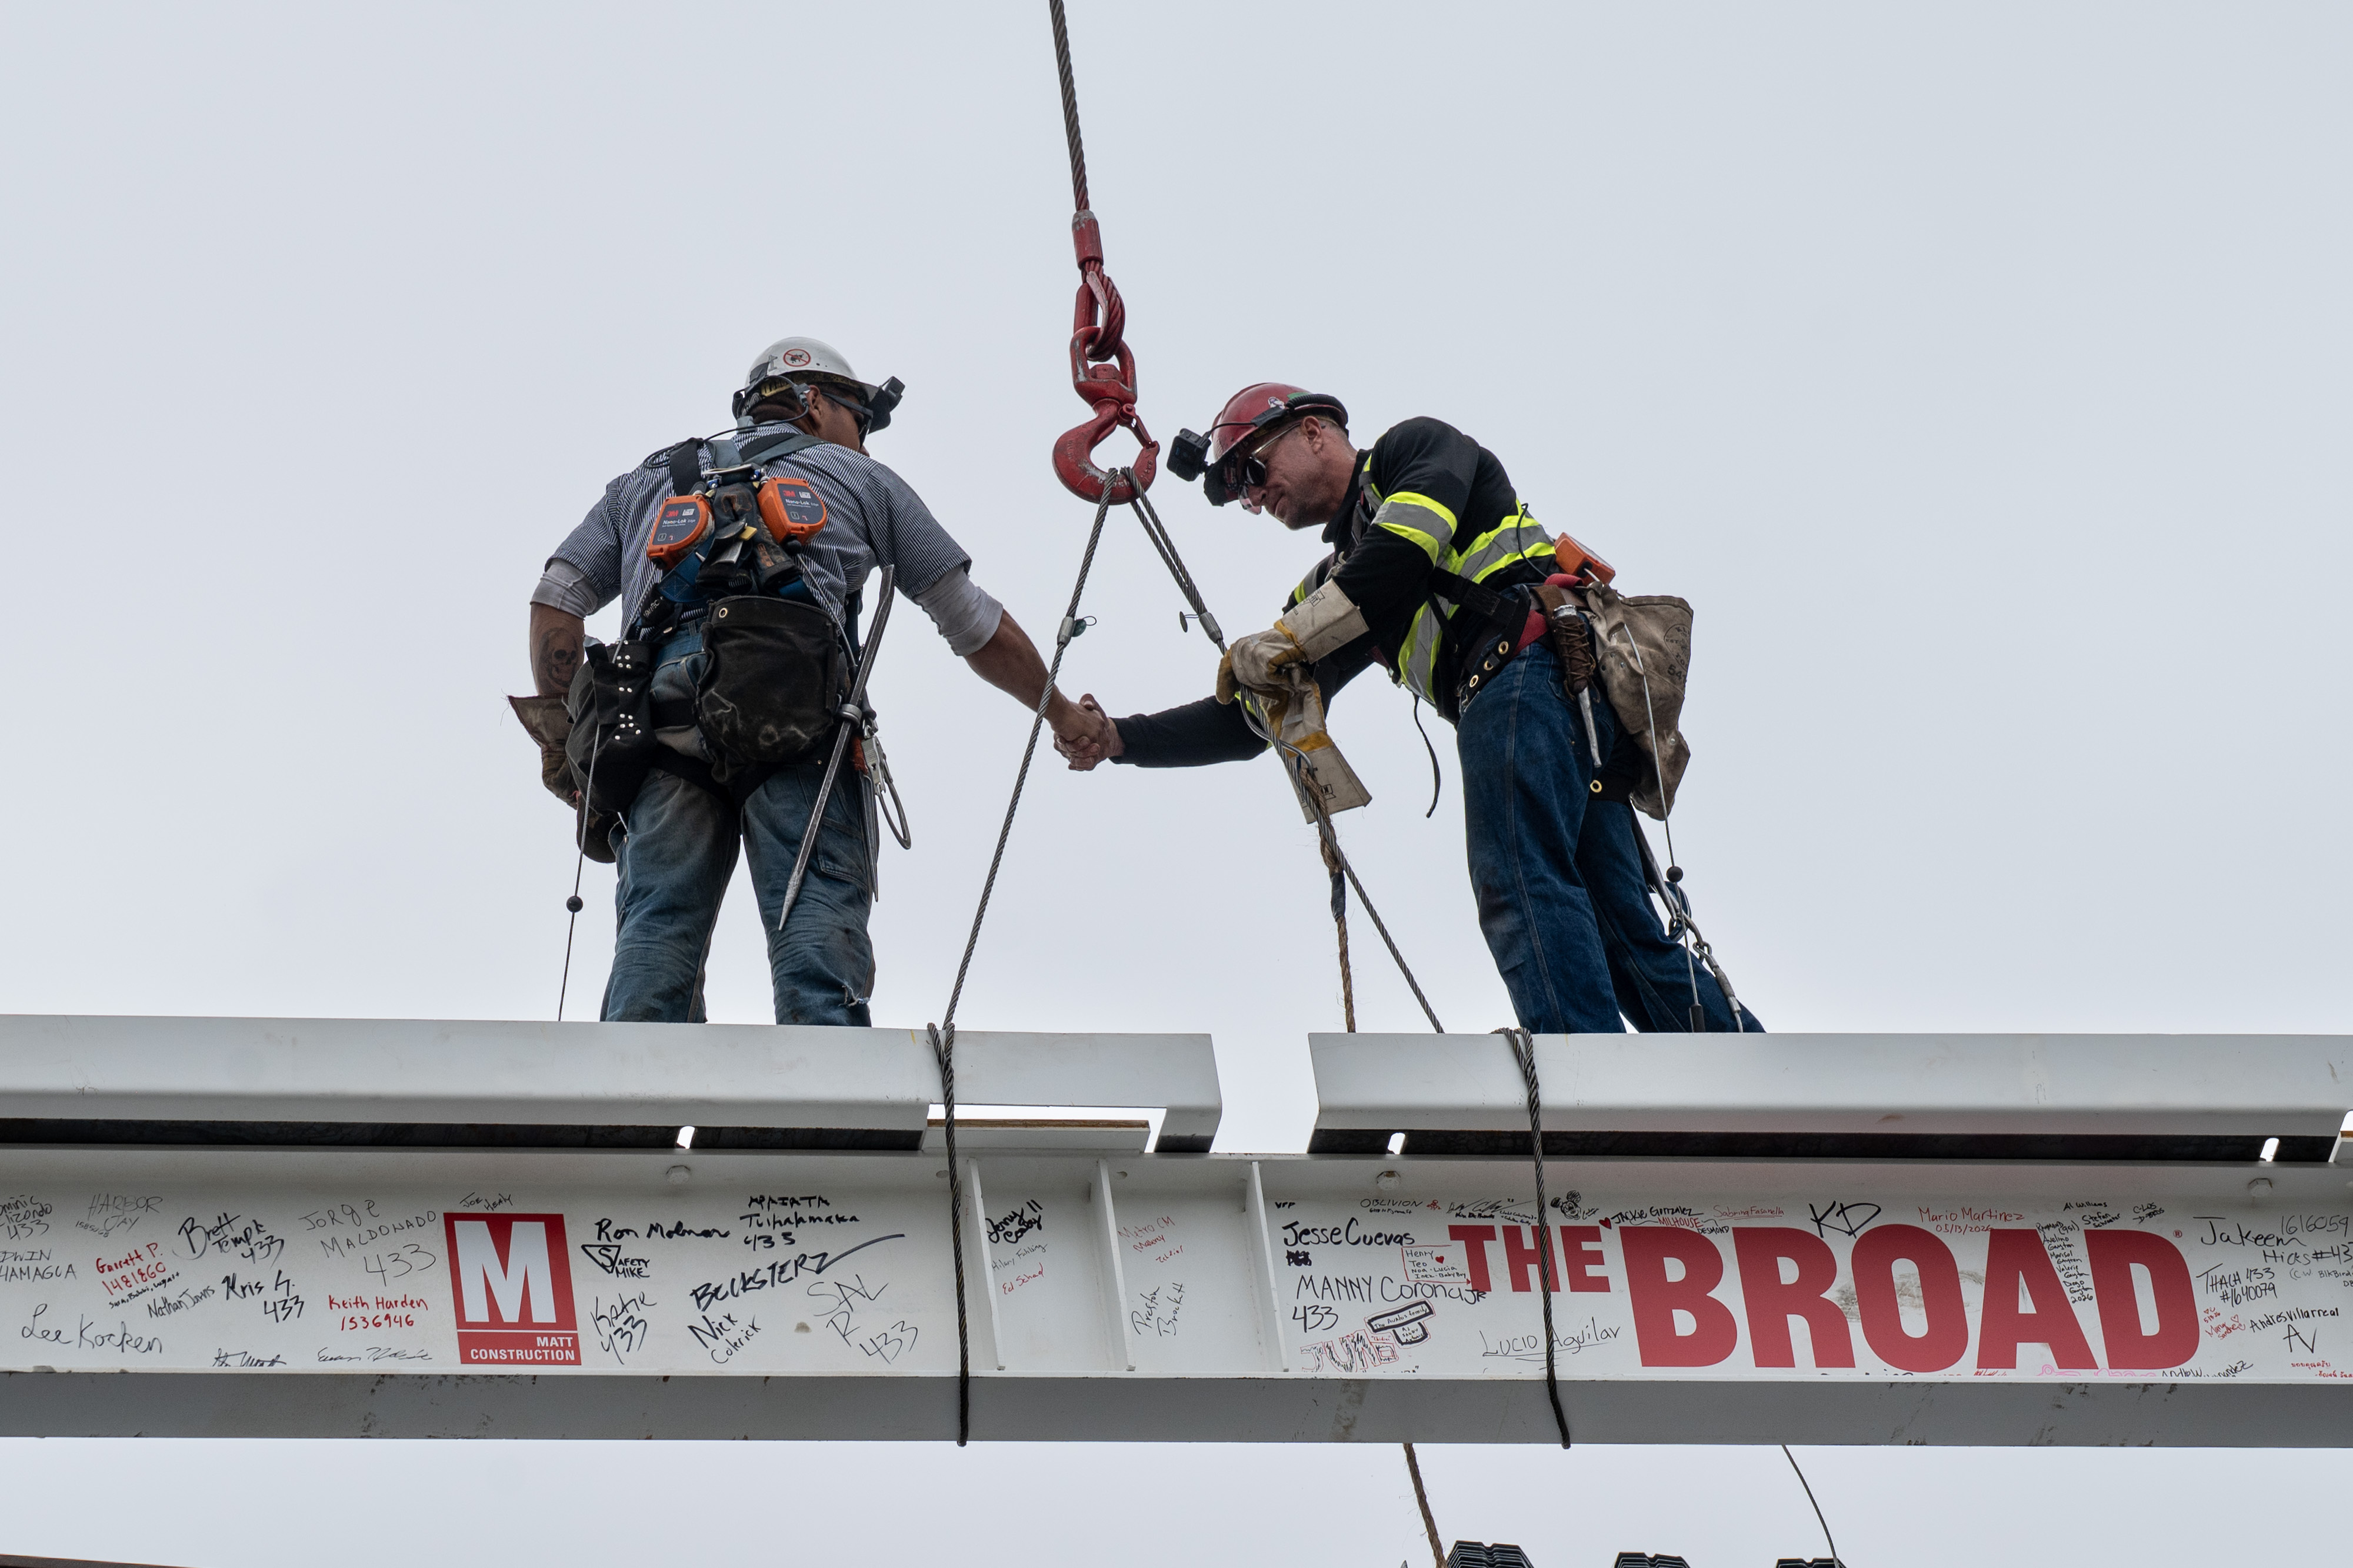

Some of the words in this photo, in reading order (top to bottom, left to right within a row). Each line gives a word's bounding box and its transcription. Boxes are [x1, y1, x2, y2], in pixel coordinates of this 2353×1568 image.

[1360, 1199, 1423, 1207] OBLIVION
[1918, 1206, 1958, 1223] Mario
[1961, 1207, 2025, 1222] Martinez
[7, 1219, 49, 1240] 433
[595, 1218, 639, 1242] Ron
[1282, 1220, 1342, 1247] Jesse
[1345, 1217, 1415, 1246] Cuevas
[1808, 1200, 1882, 1239] KD
[2081, 1212, 2112, 1225] Stefan
[2192, 1216, 2307, 1247] Jakeem
[172, 1212, 241, 1260] Brett
[320, 1210, 436, 1258] MALDONADO
[241, 1235, 285, 1270] 433
[364, 1244, 436, 1287] 433
[1405, 1249, 1434, 1260] Henry
[1448, 1225, 1612, 1292] THE
[454, 1220, 556, 1323] M
[615, 1266, 650, 1279] MIKE
[221, 1272, 265, 1301] Kris
[807, 1274, 889, 1316] SAL
[1296, 1275, 1372, 1303] MANNY
[1381, 1276, 1464, 1302] Corona
[1619, 1223, 2200, 1373] BROAD
[2070, 1293, 2094, 1304] 2026
[147, 1296, 189, 1319] Nathan
[264, 1295, 305, 1323] 433
[328, 1295, 369, 1310] Keith
[375, 1294, 428, 1311] Harden
[21, 1303, 74, 1345] Lee
[341, 1313, 415, 1331] 1536946
[687, 1312, 738, 1349] Nick
[1292, 1305, 1339, 1333] 433
[470, 1348, 575, 1360] CONSTRUCTION
[536, 1336, 573, 1347] MATT
[601, 1315, 648, 1365] 433
[859, 1320, 919, 1365] 433
